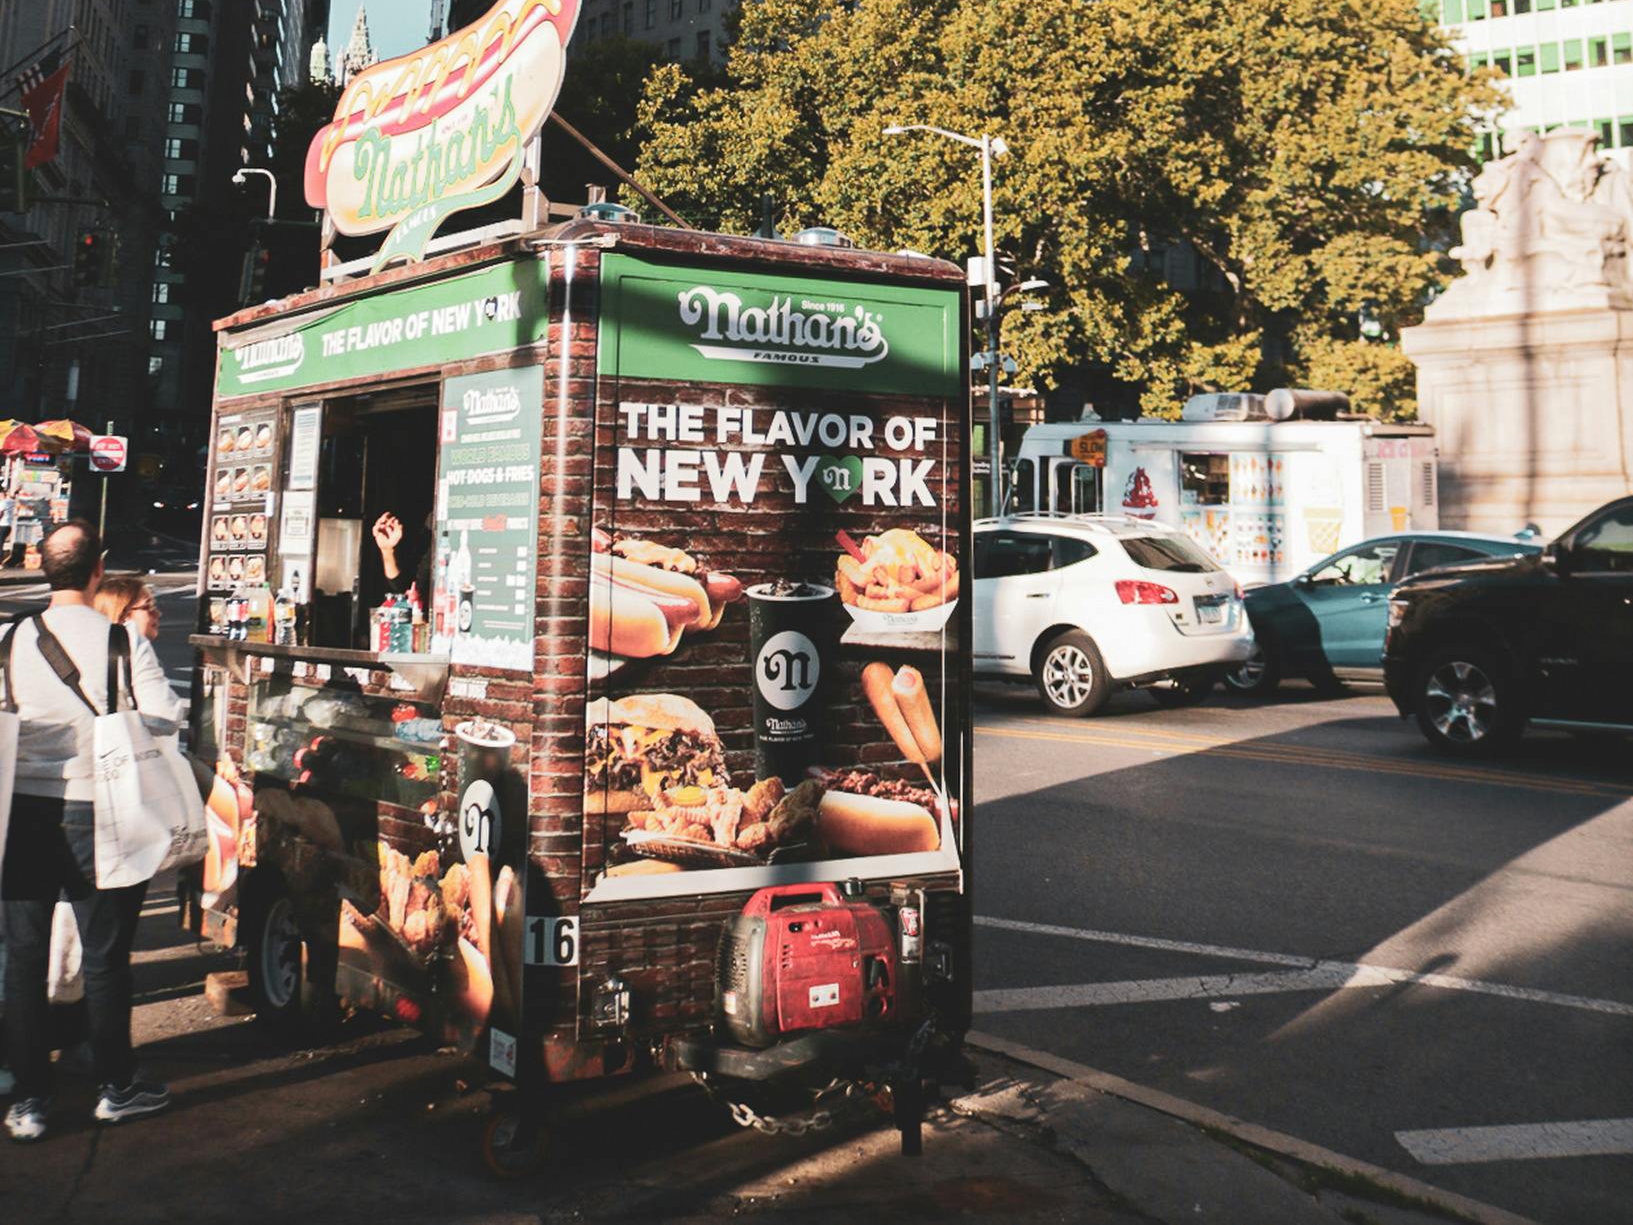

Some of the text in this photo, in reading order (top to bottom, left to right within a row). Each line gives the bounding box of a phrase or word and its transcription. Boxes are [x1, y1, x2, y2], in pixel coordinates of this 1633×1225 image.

[354, 73, 523, 218] Nathan's
[322, 331, 345, 357] THE
[347, 317, 402, 351] FLAVOR
[405, 311, 430, 341] OF
[432, 302, 471, 335] NEW
[678, 286, 883, 352] Nathan's
[801, 300, 825, 311] Since
[753, 352, 820, 364] FAMOUS
[618, 401, 937, 451] THE FLAVOR OF
[617, 447, 766, 504] NEW
[529, 917, 575, 965] 16
